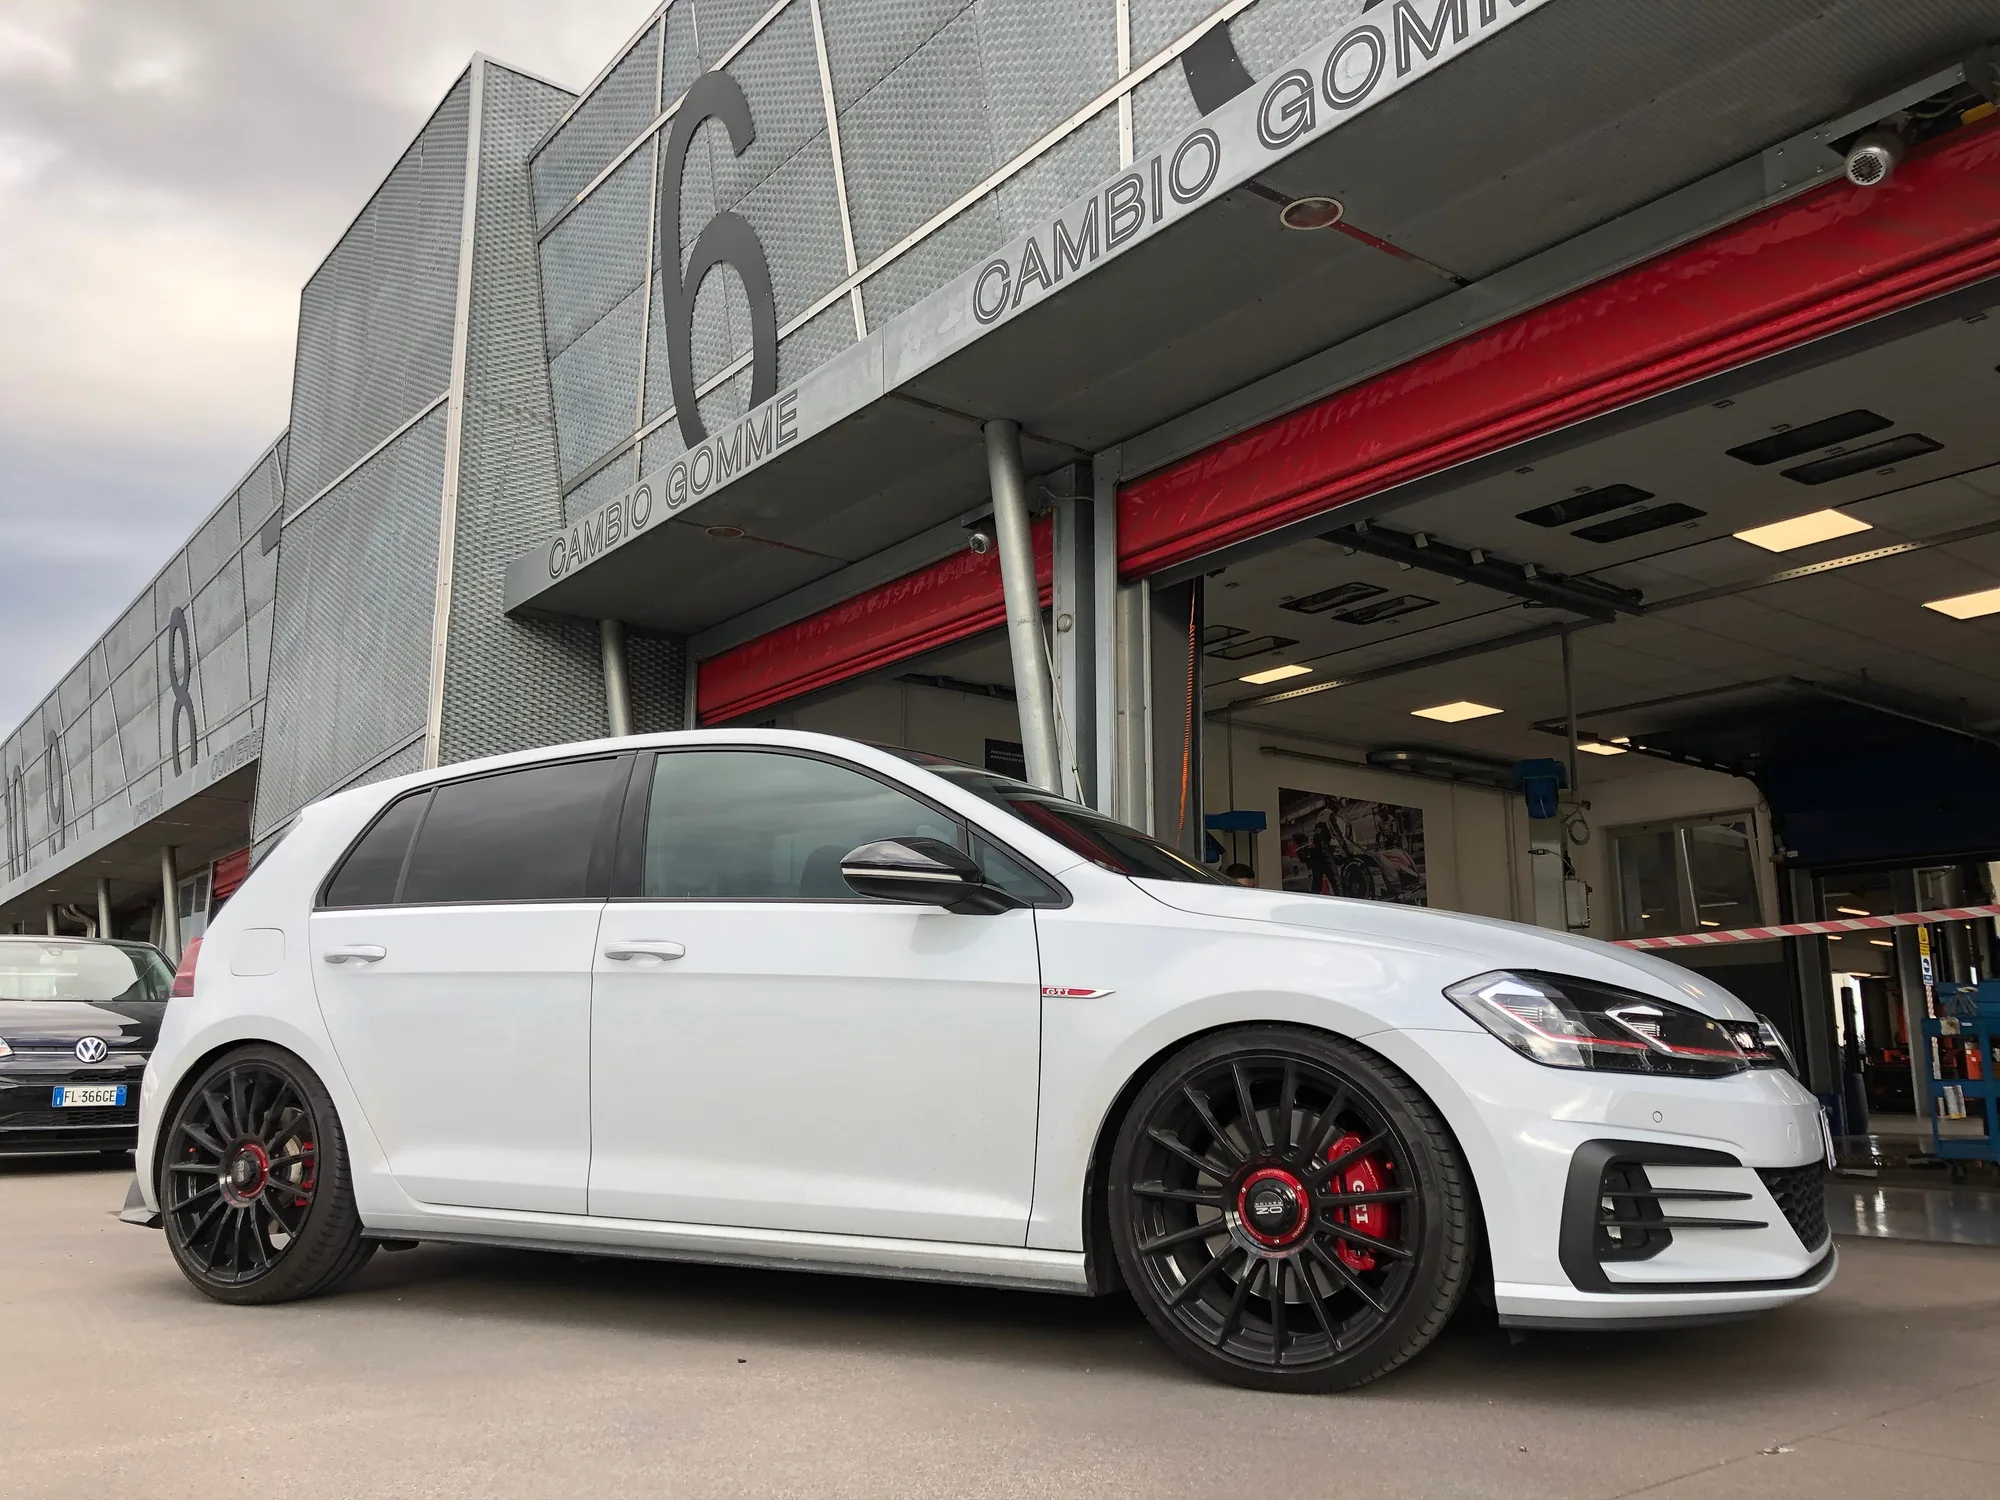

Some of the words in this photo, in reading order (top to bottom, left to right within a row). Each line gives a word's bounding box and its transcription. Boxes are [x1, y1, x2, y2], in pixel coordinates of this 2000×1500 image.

[660, 69, 778, 451] 6
[971, 127, 1222, 326] CAMBIO
[548, 483, 653, 581] CAMBIO
[665, 389, 799, 511] GOMME
[1046, 988, 1070, 996] GTI
